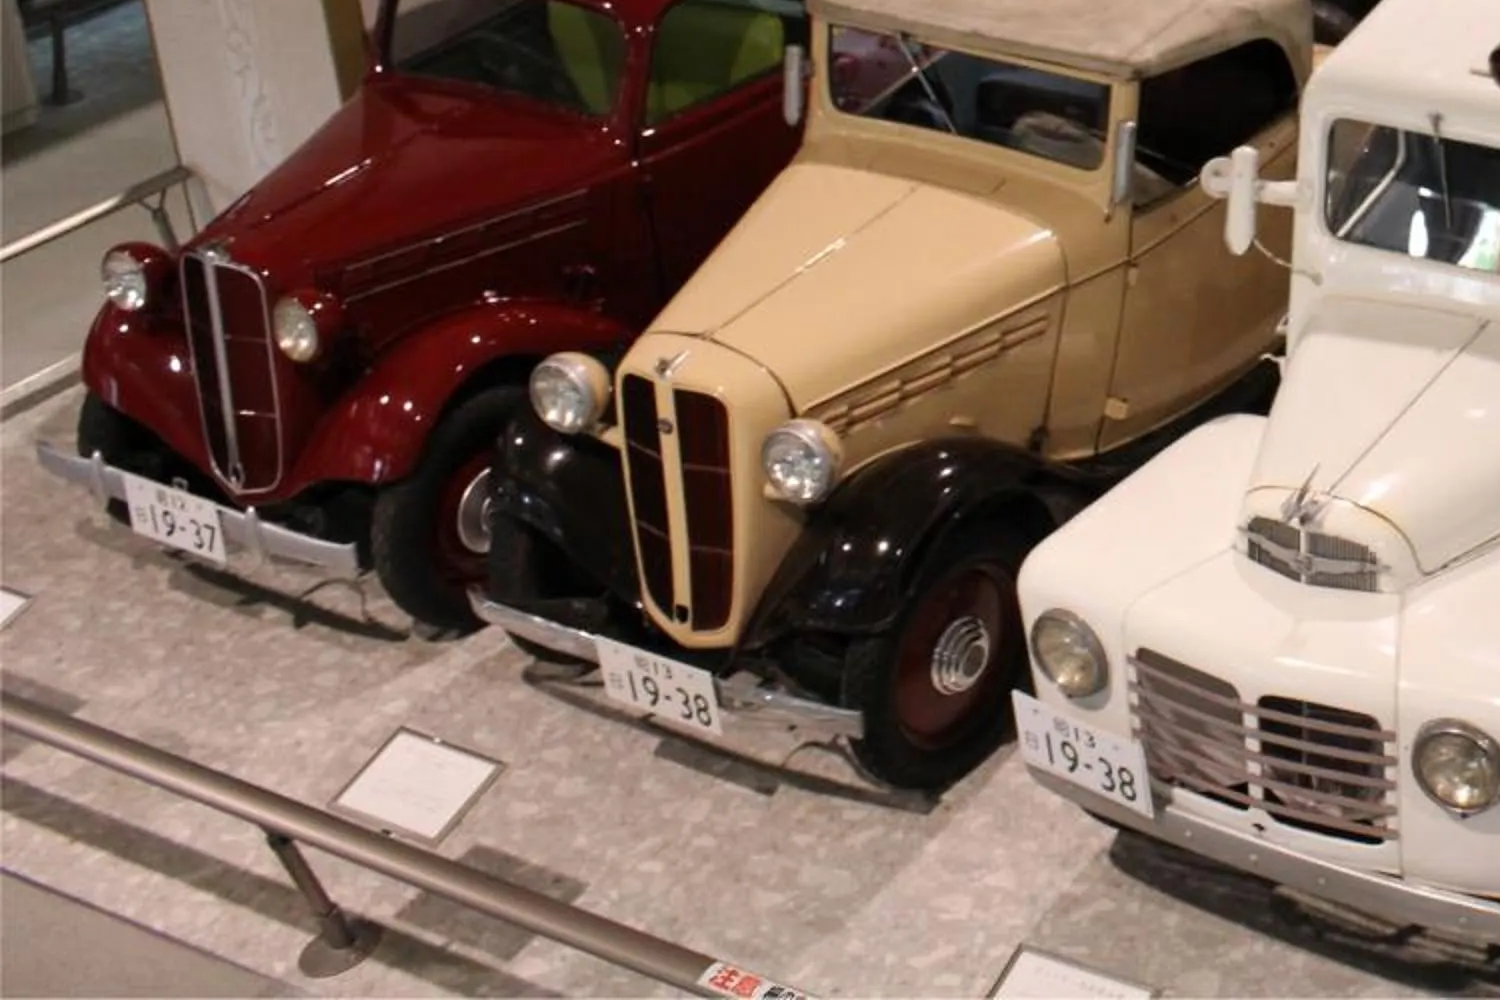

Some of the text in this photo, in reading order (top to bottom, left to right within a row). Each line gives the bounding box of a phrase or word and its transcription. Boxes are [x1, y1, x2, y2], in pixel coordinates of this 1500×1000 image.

[149, 503, 216, 553] 19-37
[627, 669, 713, 728] 19-38
[1045, 732, 1137, 803] 19-38
